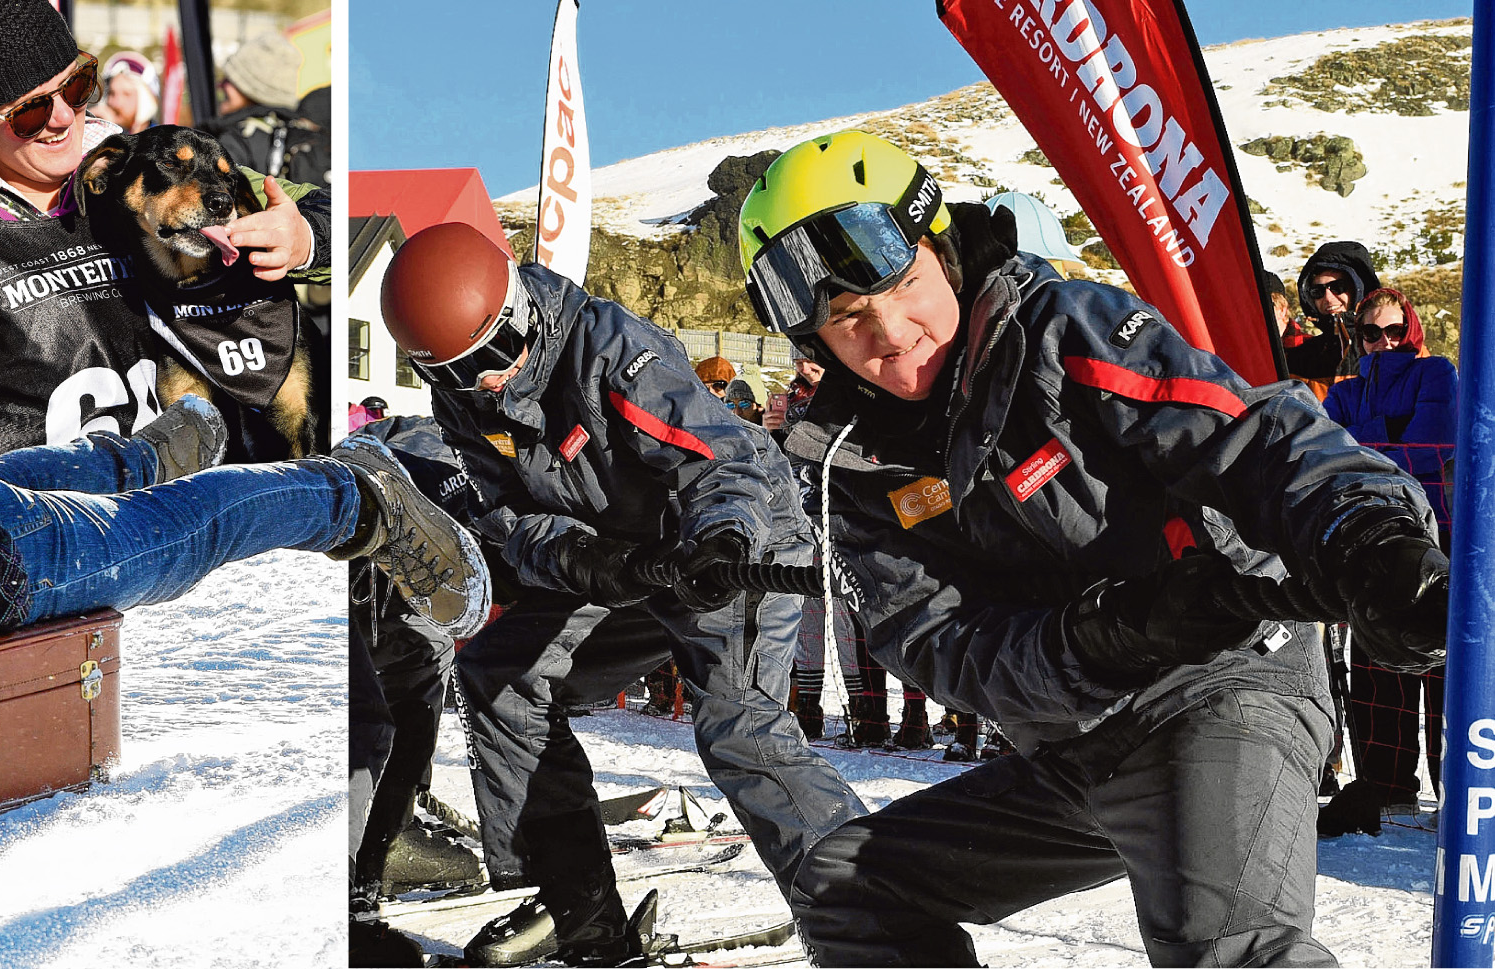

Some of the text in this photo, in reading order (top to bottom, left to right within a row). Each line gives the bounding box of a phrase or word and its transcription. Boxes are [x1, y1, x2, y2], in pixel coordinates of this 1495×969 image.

[1009, 3, 1070, 88] RESORT
[1079, 107, 1114, 156] NEW
[1109, 154, 1195, 268] ZEALAND
[908, 173, 938, 224] SMITH
[21, 257, 50, 268] COAST
[50, 245, 87, 262] 1868
[60, 289, 111, 309] BREWING
[217, 338, 266, 376] 69
[1015, 451, 1066, 494] CARDRONA
[1021, 456, 1044, 477] Stirling
